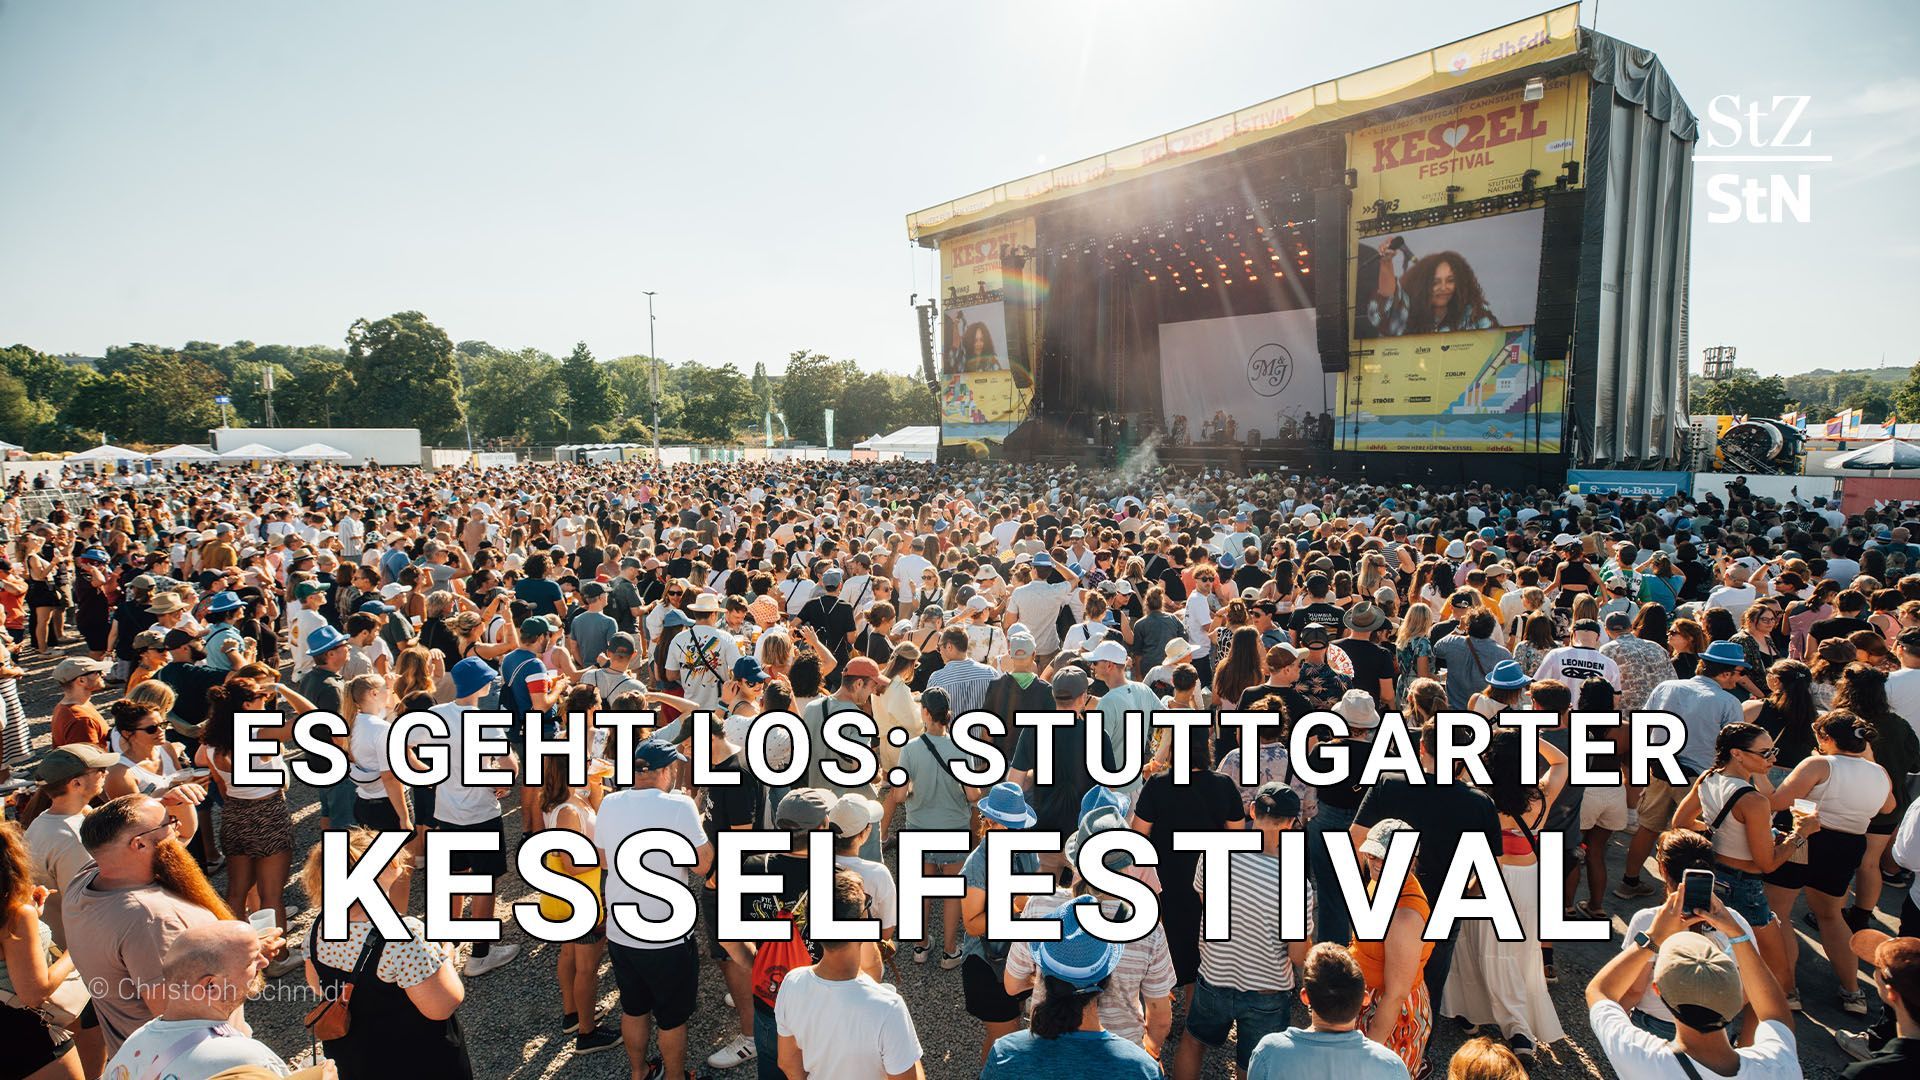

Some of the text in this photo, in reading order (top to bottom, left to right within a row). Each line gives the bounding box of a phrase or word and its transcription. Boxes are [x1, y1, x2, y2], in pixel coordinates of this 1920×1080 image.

[1470, 90, 1524, 110] CANNSTATTE
[1418, 152, 1495, 180] FESTIVAL
[1371, 199, 1400, 214] SR3
[1561, 658, 1605, 670] LEONIDEN
